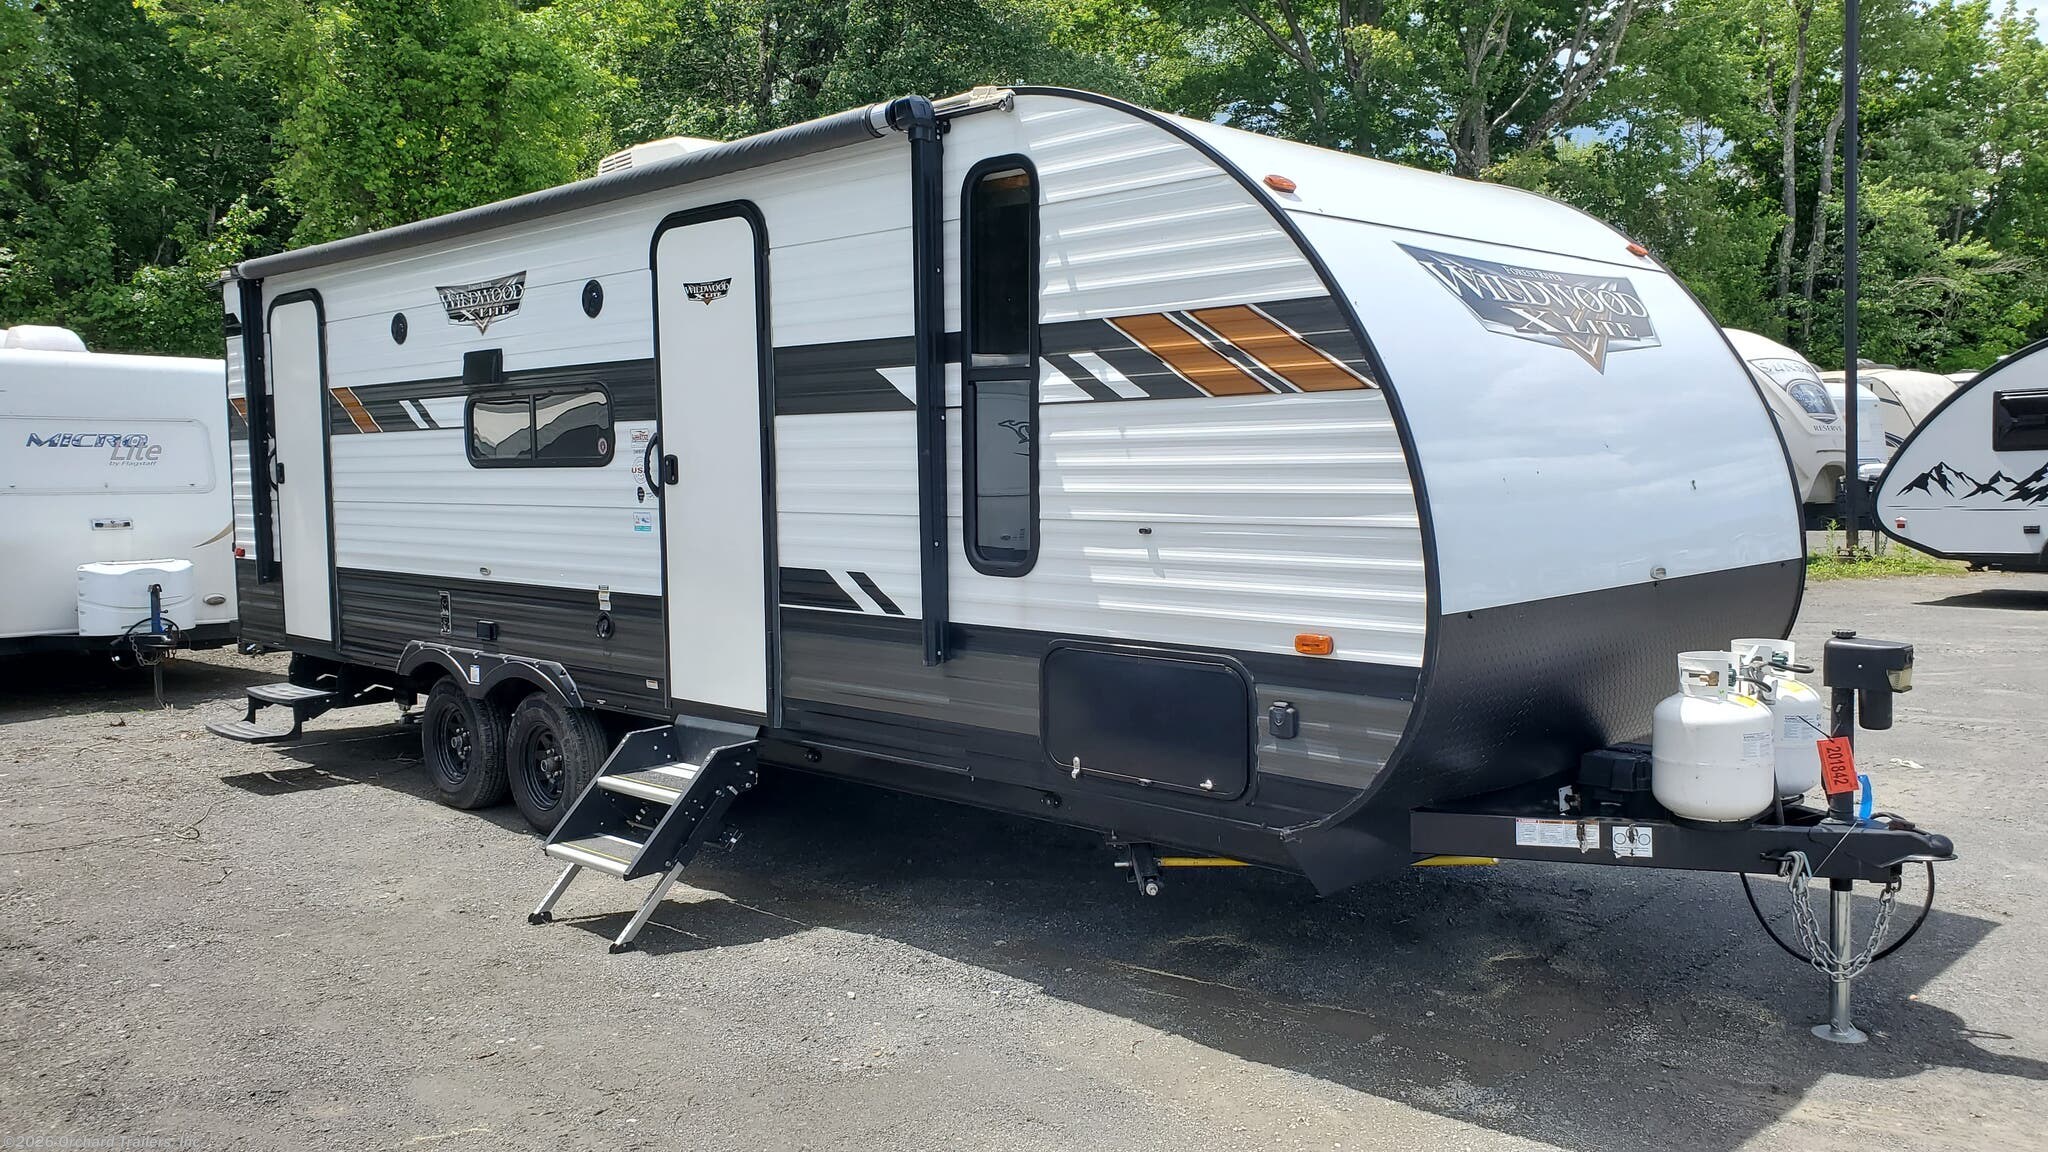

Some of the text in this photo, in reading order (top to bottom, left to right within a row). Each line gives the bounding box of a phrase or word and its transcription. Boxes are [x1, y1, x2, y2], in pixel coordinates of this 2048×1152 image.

[440, 284, 524, 310] WILDWOOD
[684, 281, 730, 294] WILDWOOD
[1418, 260, 1649, 318] WILDWOOD
[460, 305, 510, 321] X LITE
[1502, 305, 1639, 338] X LITE
[26, 433, 148, 448] MICRO
[110, 440, 162, 461] Lite
[1826, 746, 1849, 786] 201842
